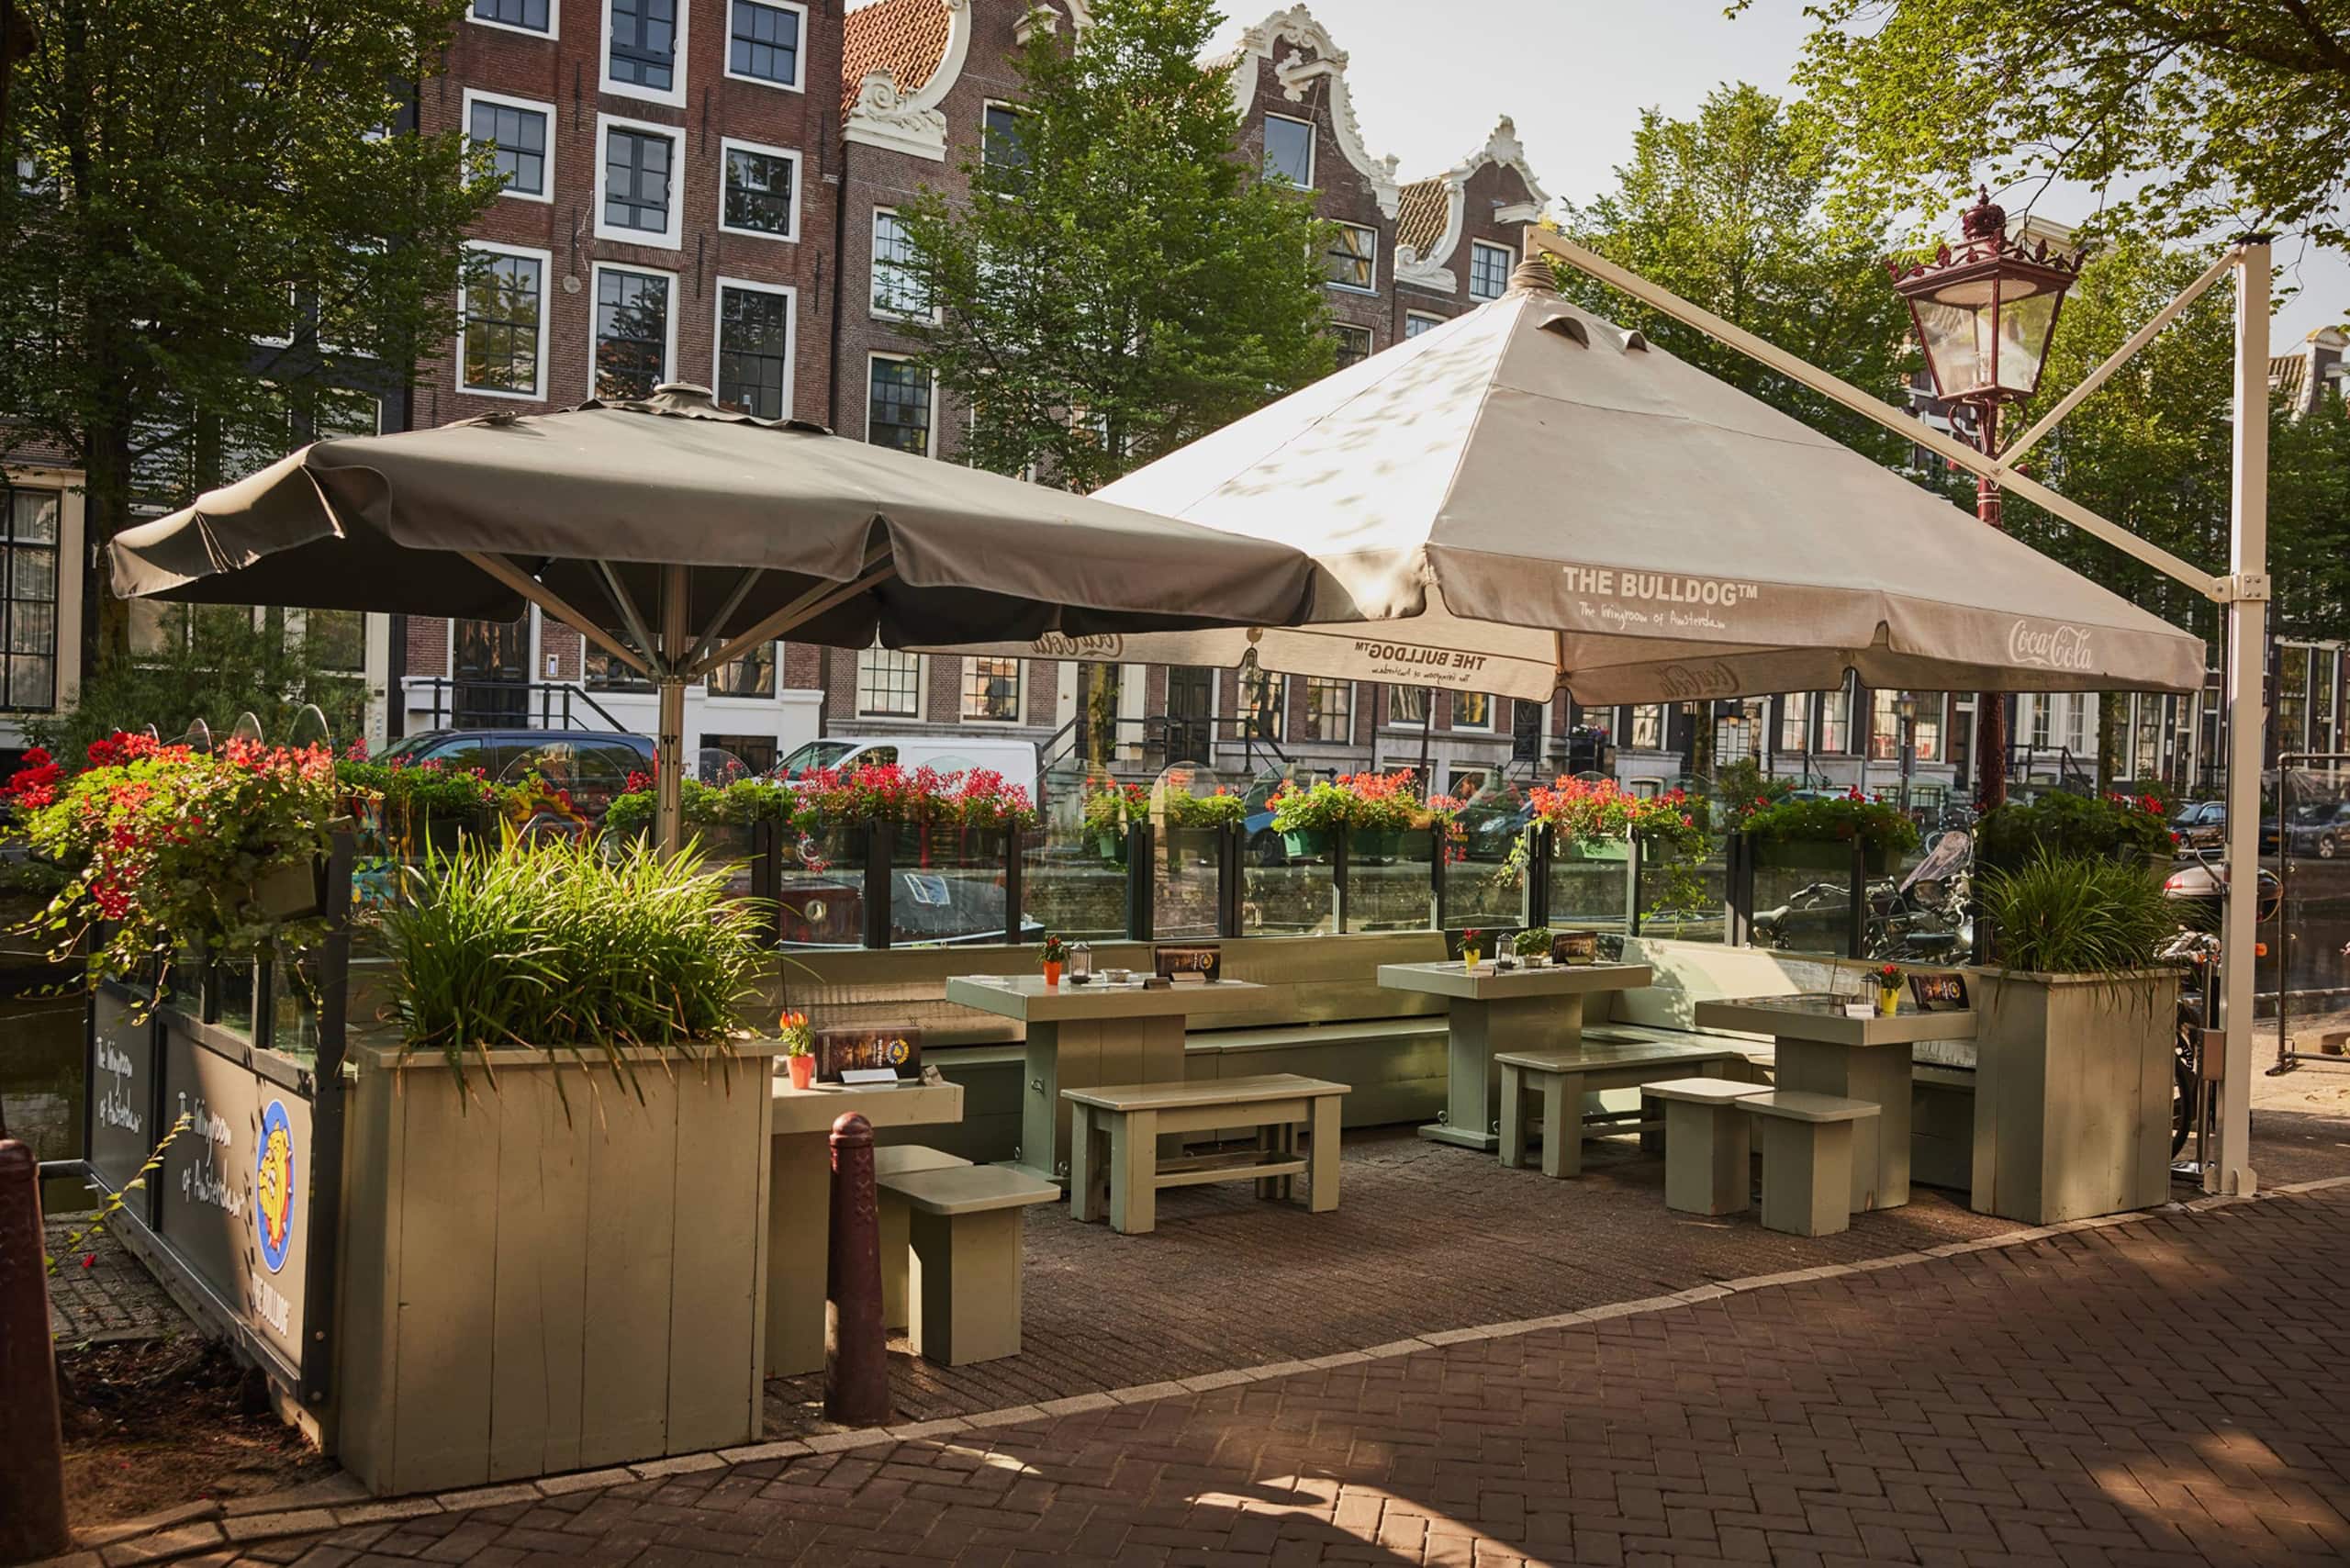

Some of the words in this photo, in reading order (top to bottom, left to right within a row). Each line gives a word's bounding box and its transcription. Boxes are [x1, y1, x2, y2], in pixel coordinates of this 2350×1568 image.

[1562, 566, 1614, 596] THE
[1578, 601, 1596, 618] The
[1600, 603, 1648, 631] livingroom
[1653, 612, 1664, 627] of
[1669, 610, 1726, 630] Amsterdam
